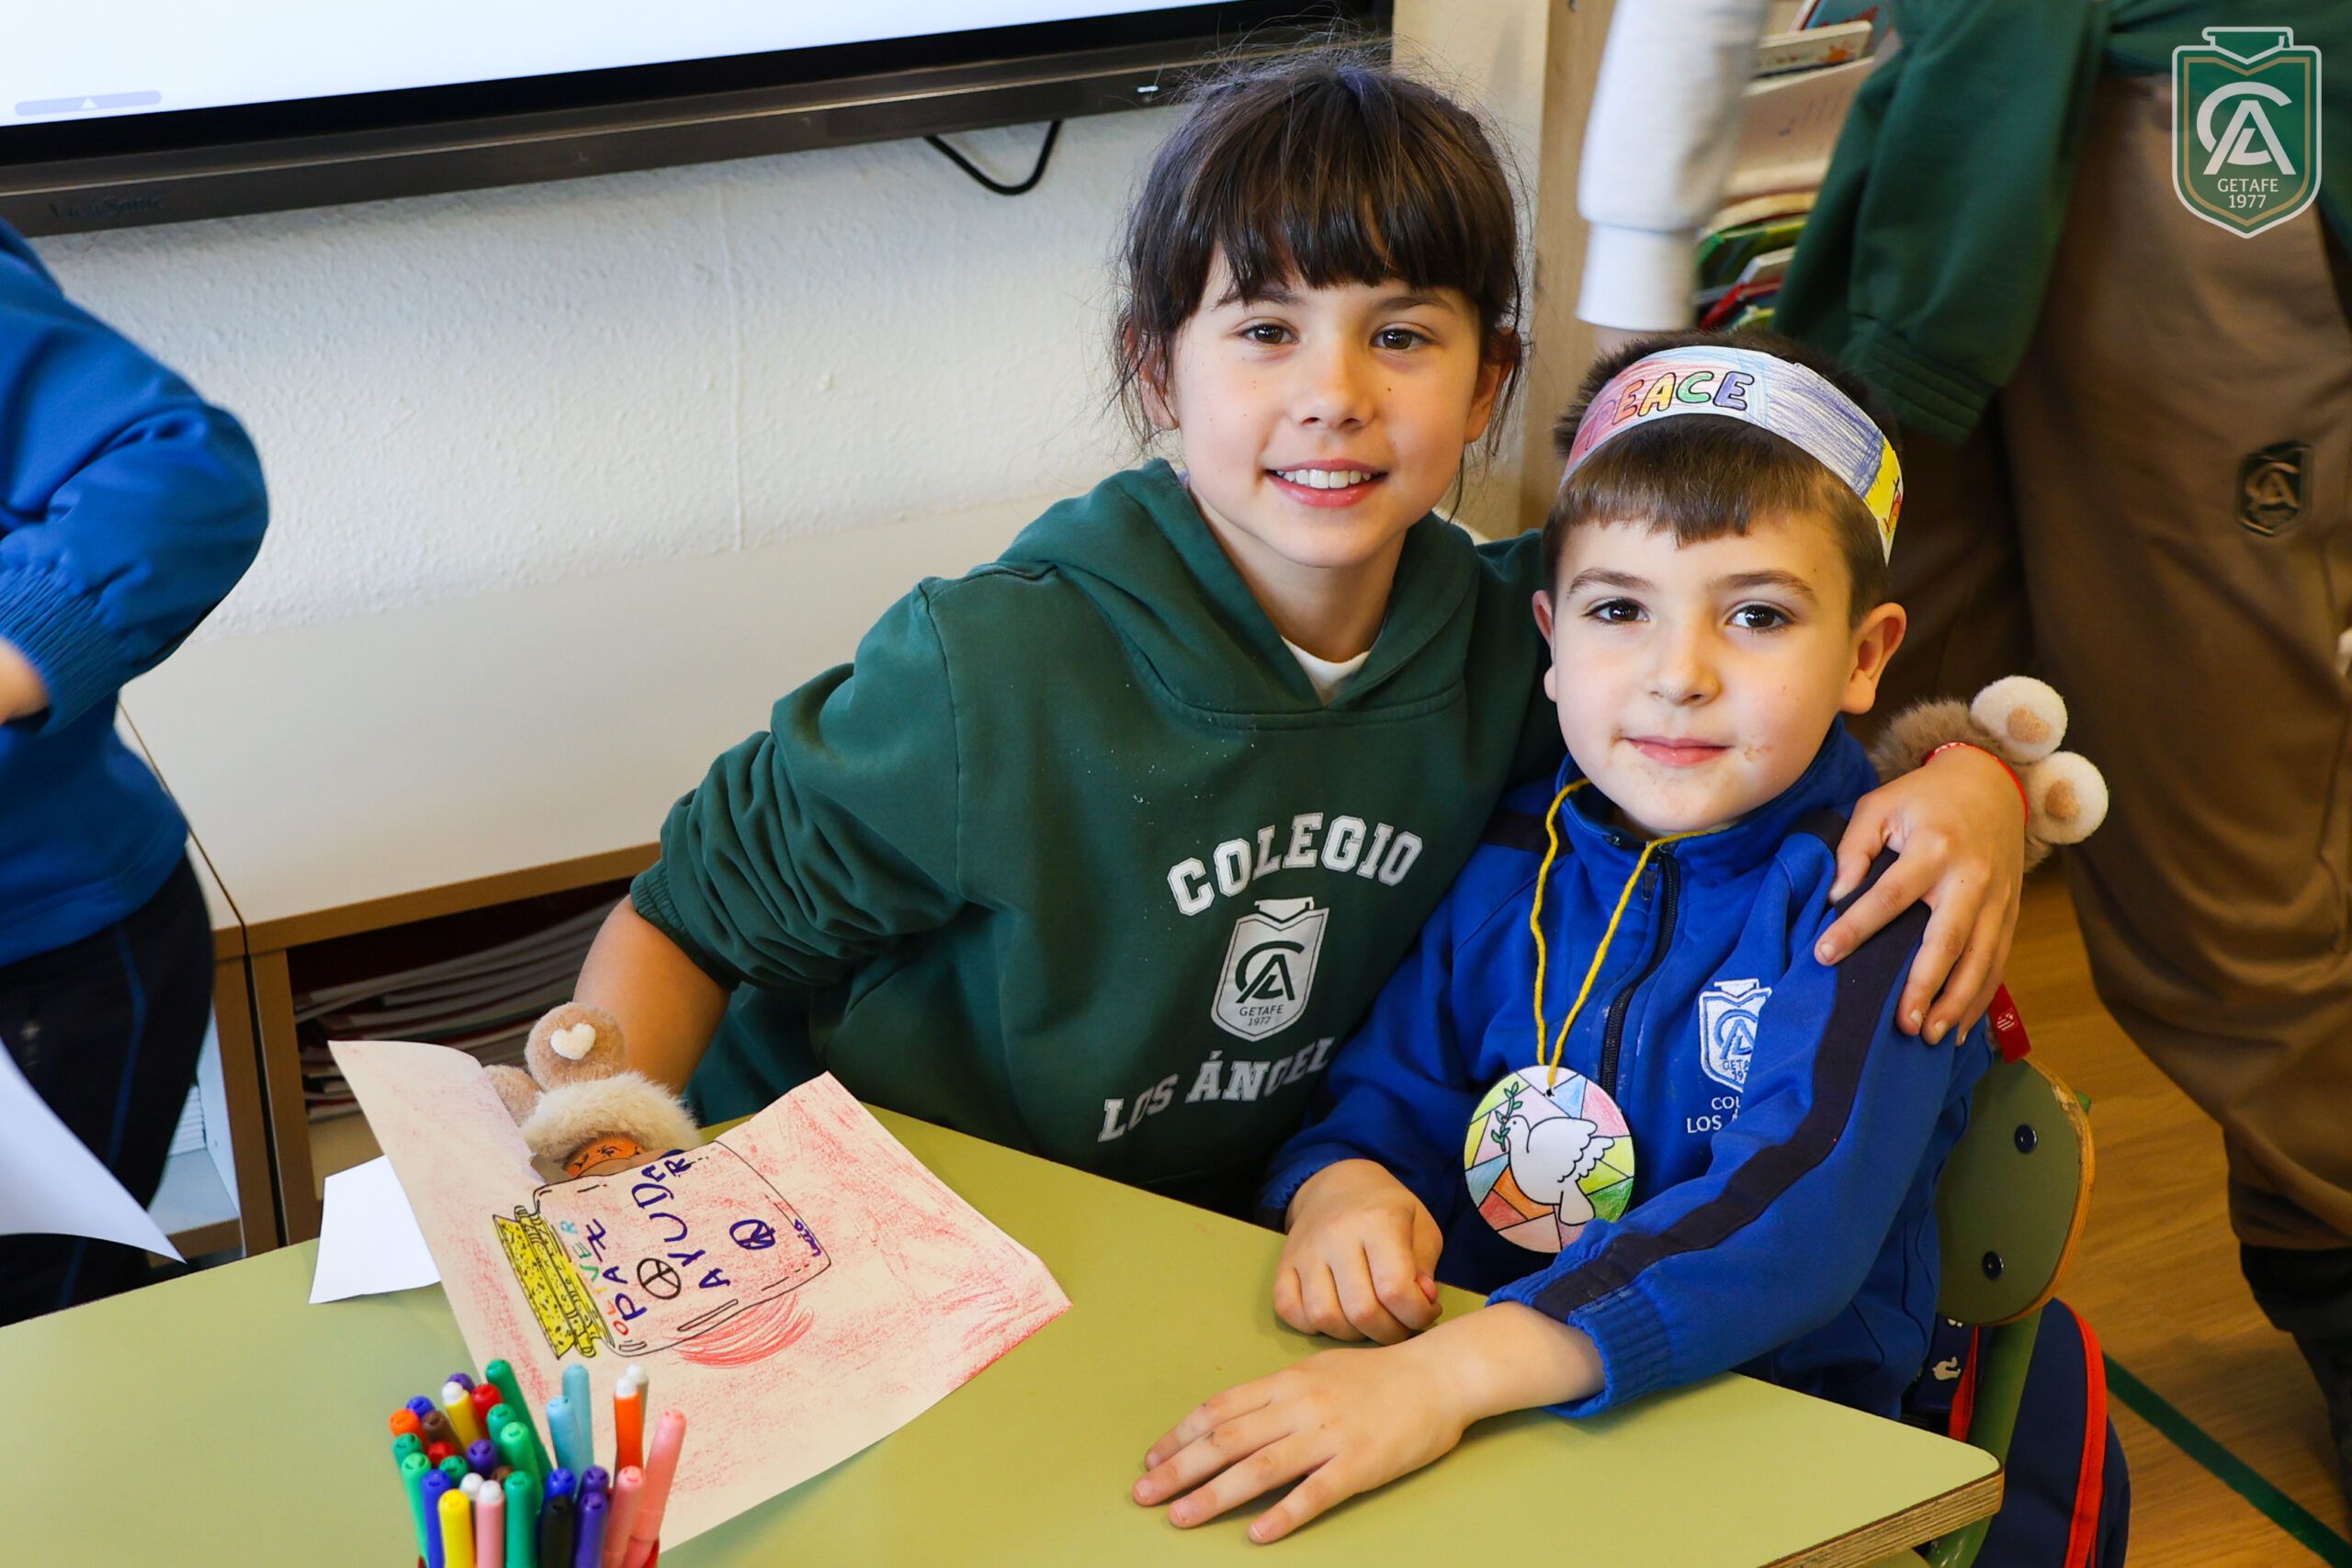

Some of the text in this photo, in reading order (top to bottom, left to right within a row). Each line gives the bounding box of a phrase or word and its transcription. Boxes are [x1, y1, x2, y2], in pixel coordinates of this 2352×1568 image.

[1585, 371, 1755, 450] PEACE
[1167, 812, 1423, 917] COLEGIO
[1239, 1004, 1284, 1017] GETAFE
[1248, 1016, 1272, 1027] 1977
[1686, 1114, 1723, 1134] LOS
[560, 1219, 629, 1337] OLIVER
[586, 1218, 648, 1321] PAZ
